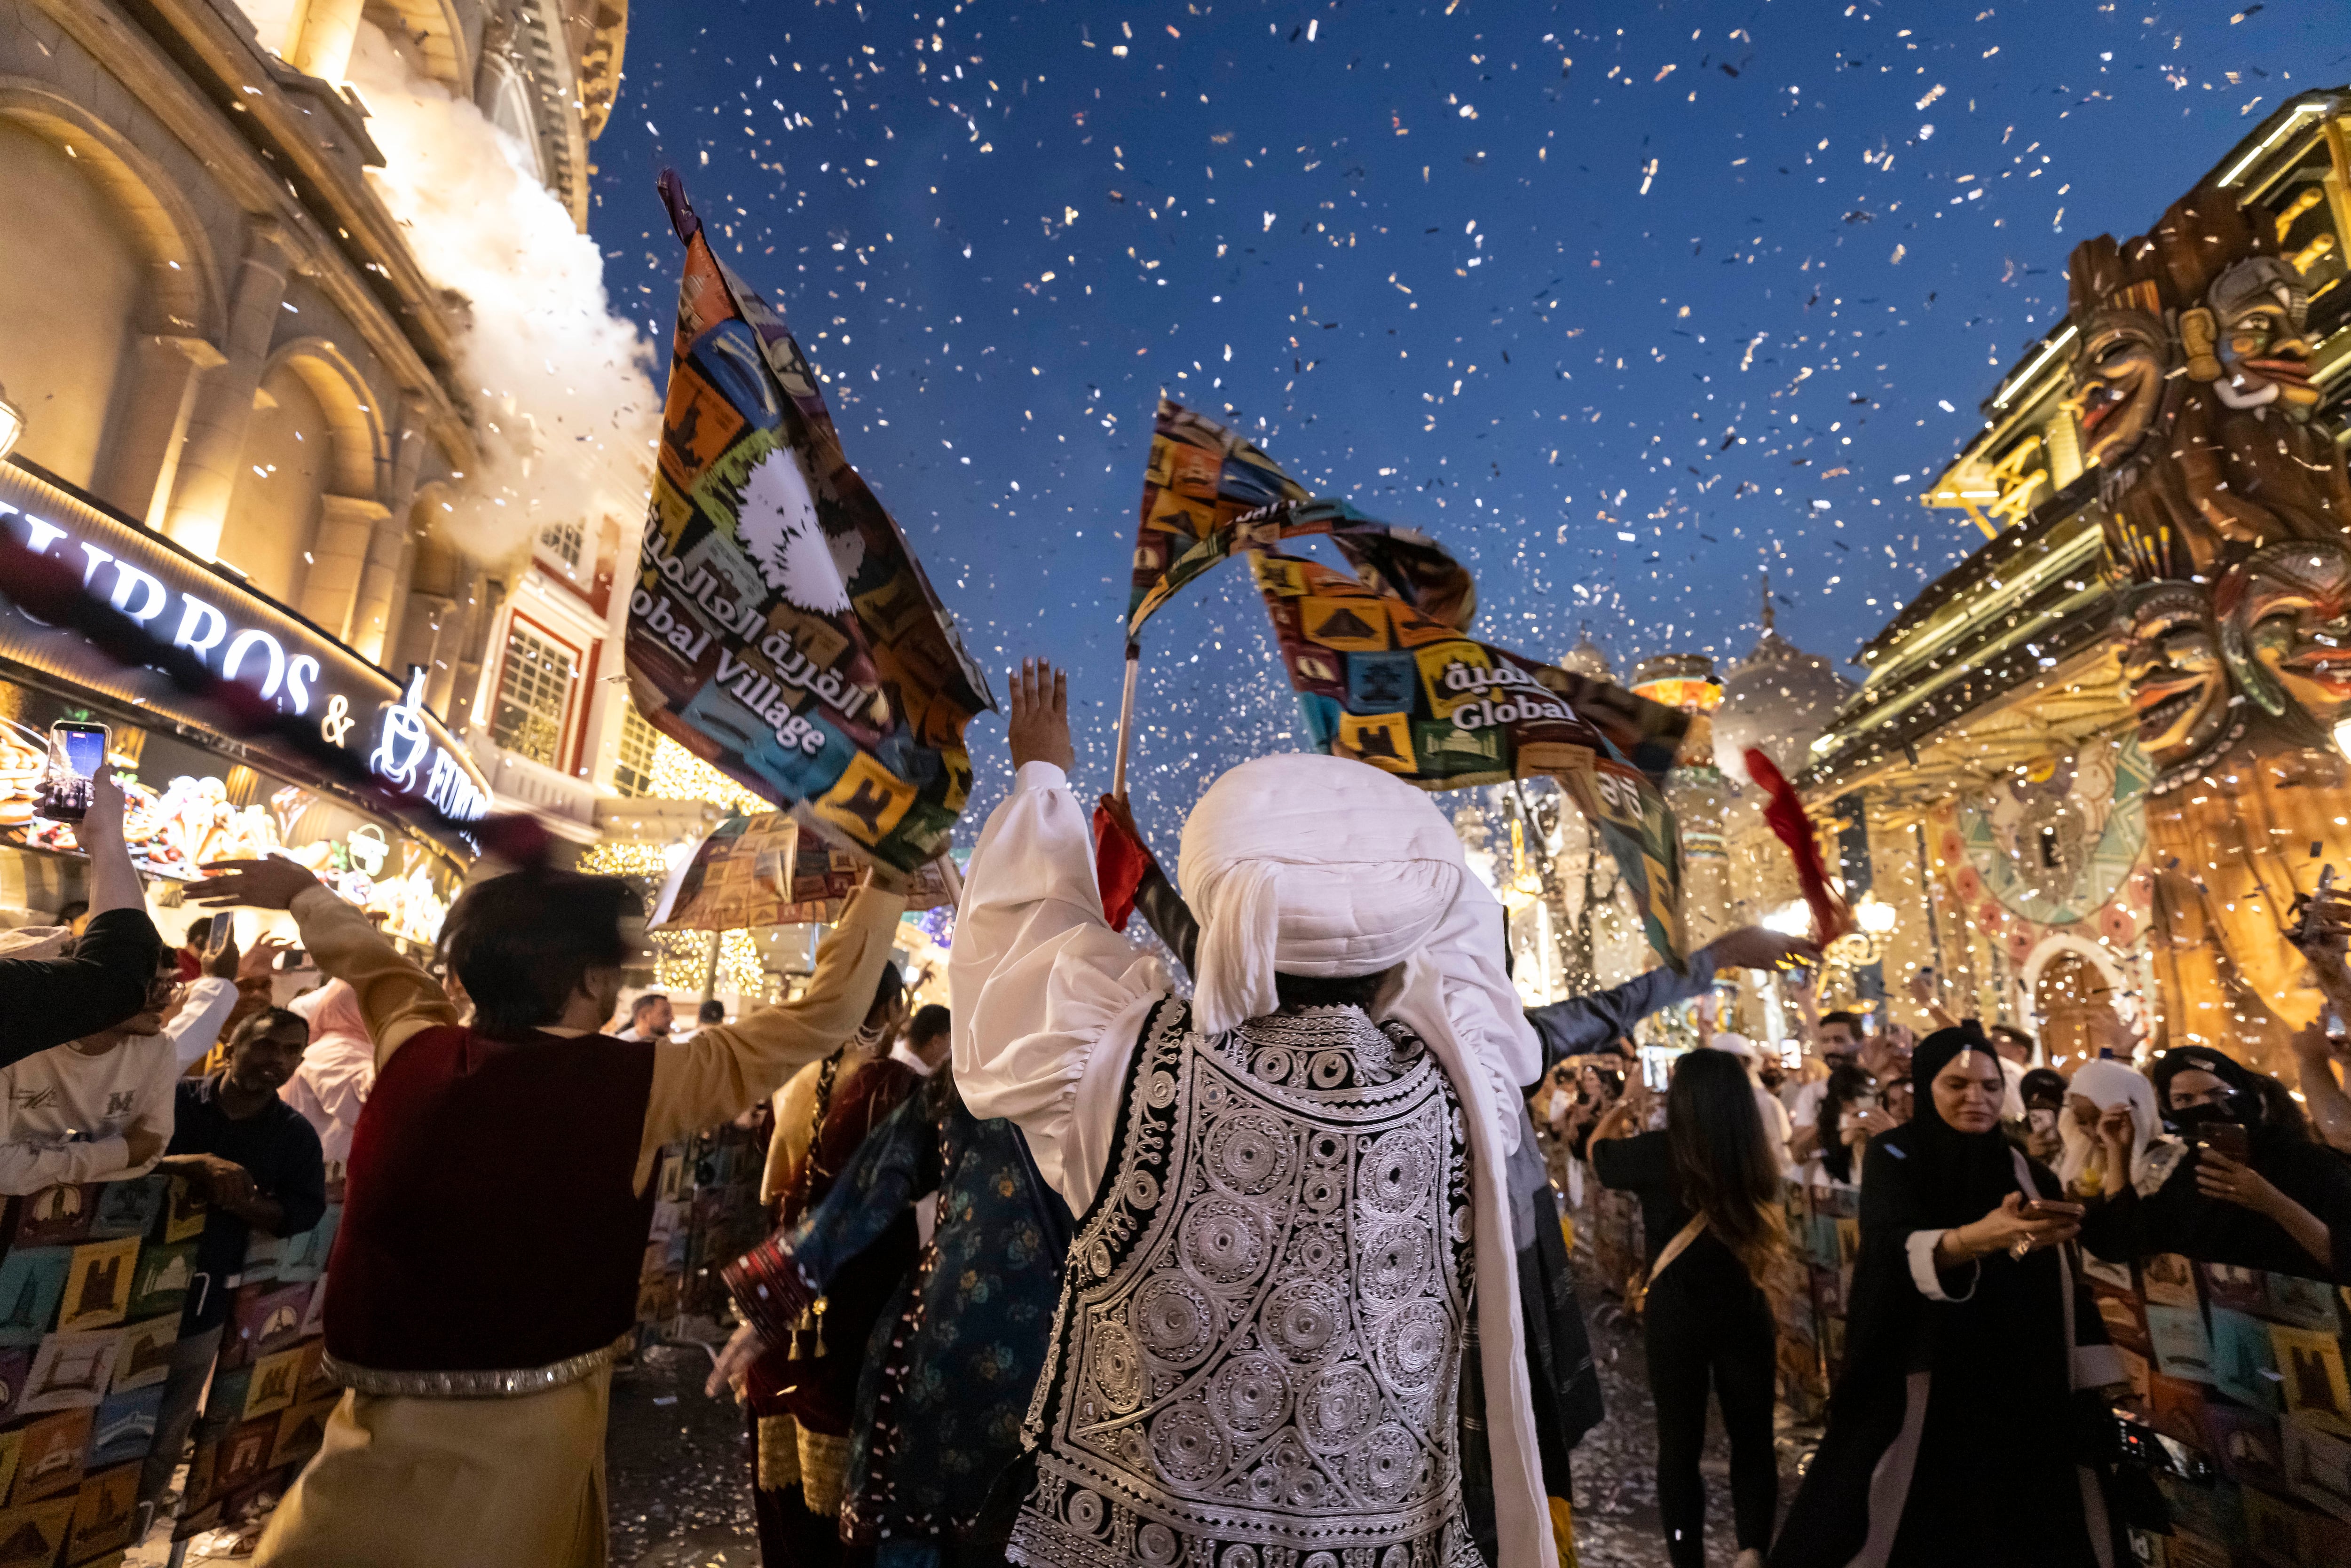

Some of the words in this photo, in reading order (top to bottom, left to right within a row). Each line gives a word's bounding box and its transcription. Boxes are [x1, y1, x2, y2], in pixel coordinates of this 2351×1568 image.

[715, 647, 826, 754] Village
[761, 629, 868, 719] القرية
[321, 694, 355, 749] &
[1451, 694, 1579, 730] Global
